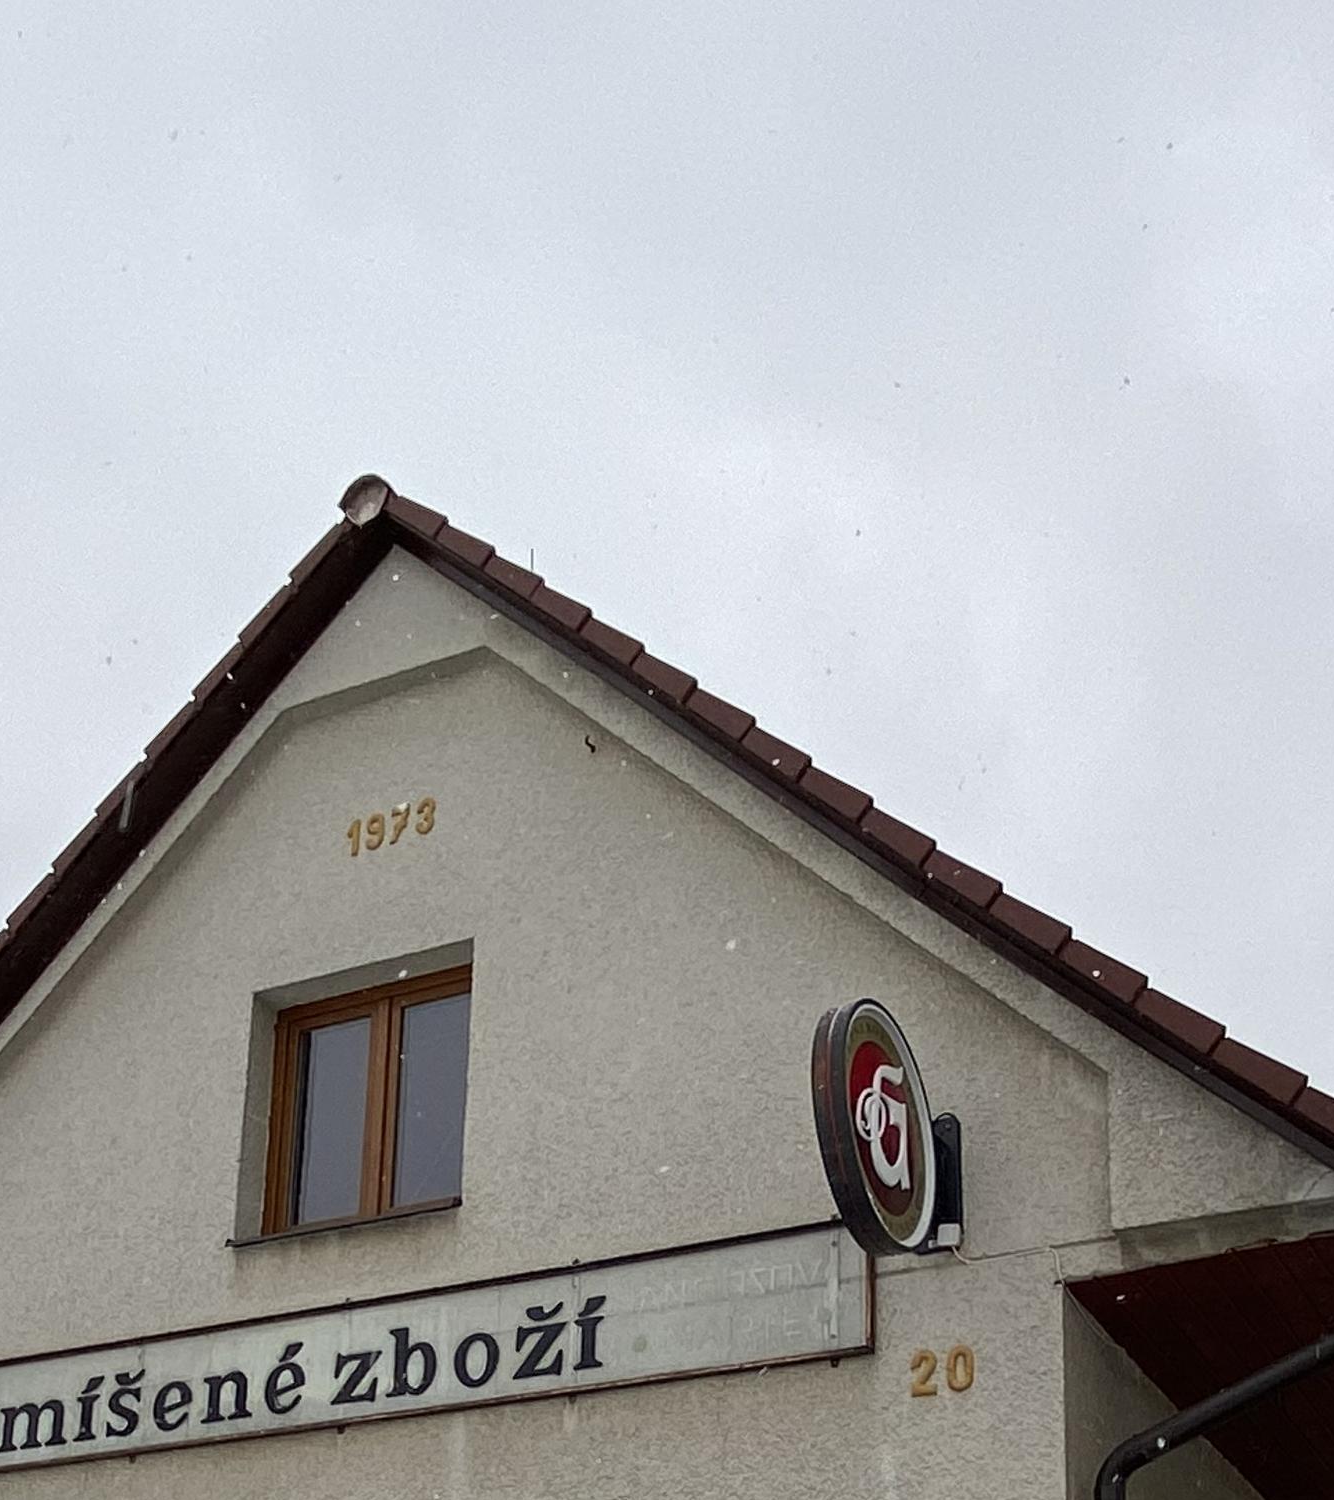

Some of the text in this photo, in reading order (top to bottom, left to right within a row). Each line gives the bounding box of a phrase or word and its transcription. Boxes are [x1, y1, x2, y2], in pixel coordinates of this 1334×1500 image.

[347, 798, 436, 857] 1973
[330, 1295, 607, 1405] zboží
[911, 1344, 974, 1398] 20
